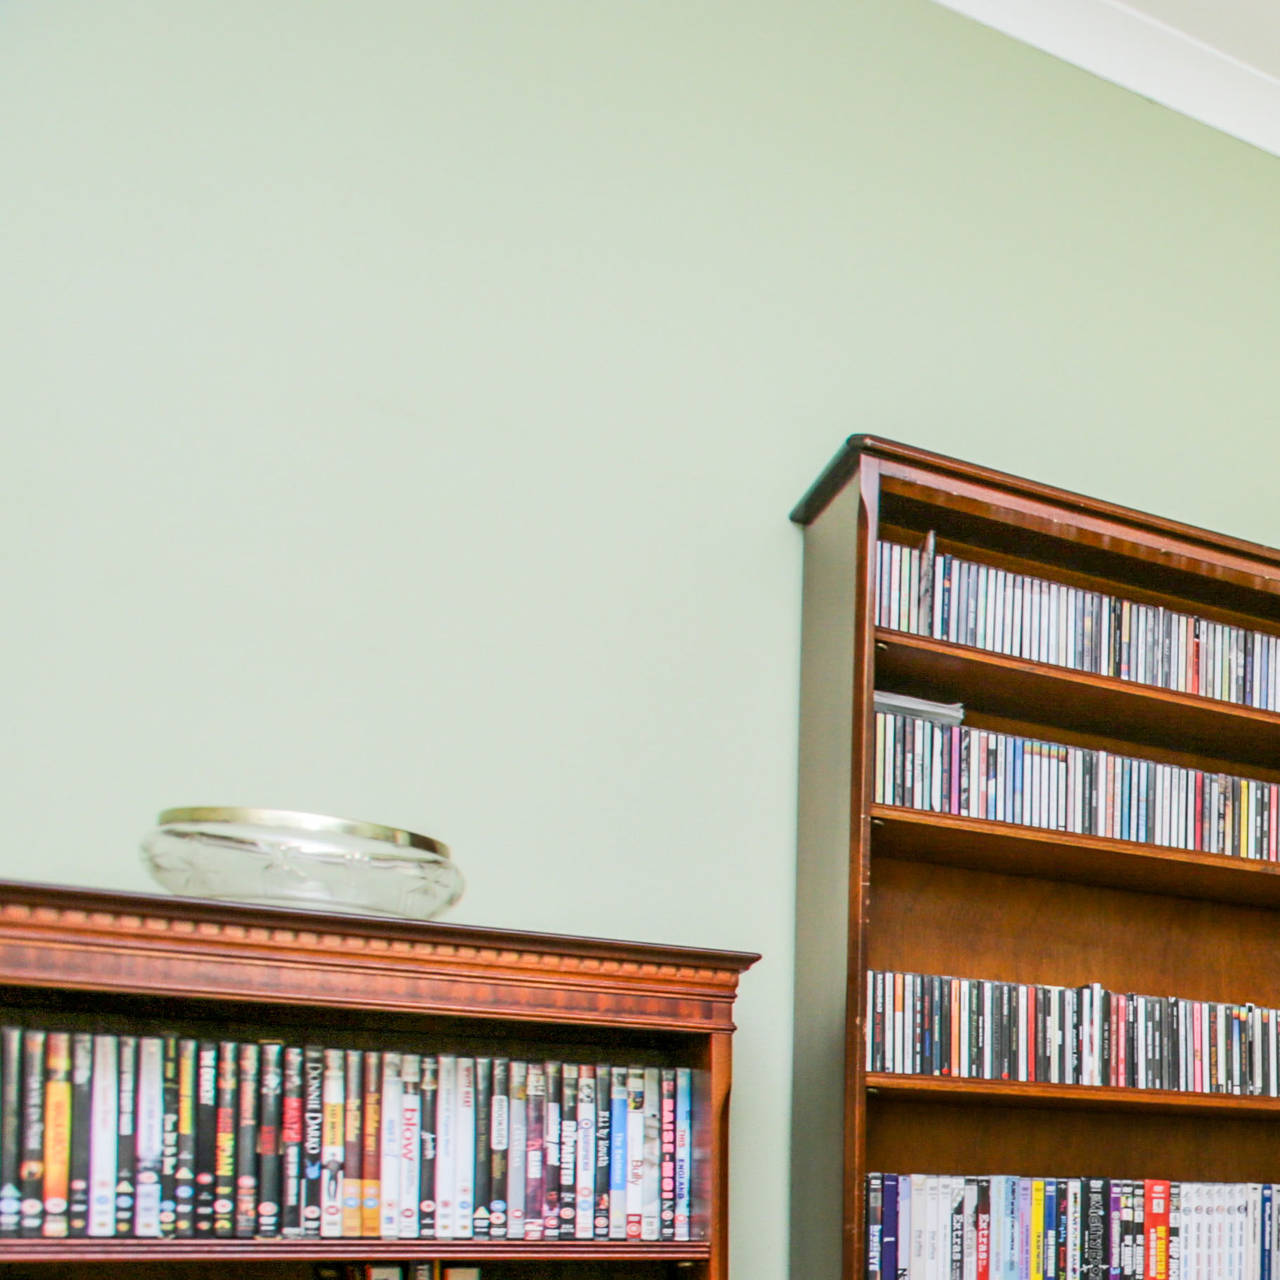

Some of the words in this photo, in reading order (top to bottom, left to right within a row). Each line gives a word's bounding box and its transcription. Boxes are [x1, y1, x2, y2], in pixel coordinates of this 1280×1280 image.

[305, 1063, 322, 1109] DONNIE
[305, 1112, 322, 1154] DARKO
[402, 1108, 417, 1161] blow
[598, 1111, 610, 1127] Nil
[598, 1140, 610, 1167] Mouth
[627, 1160, 643, 1186] Bully
[677, 1158, 687, 1200] ENGLAND
[952, 1213, 964, 1260] Extras
[978, 1213, 990, 1259] Extras
